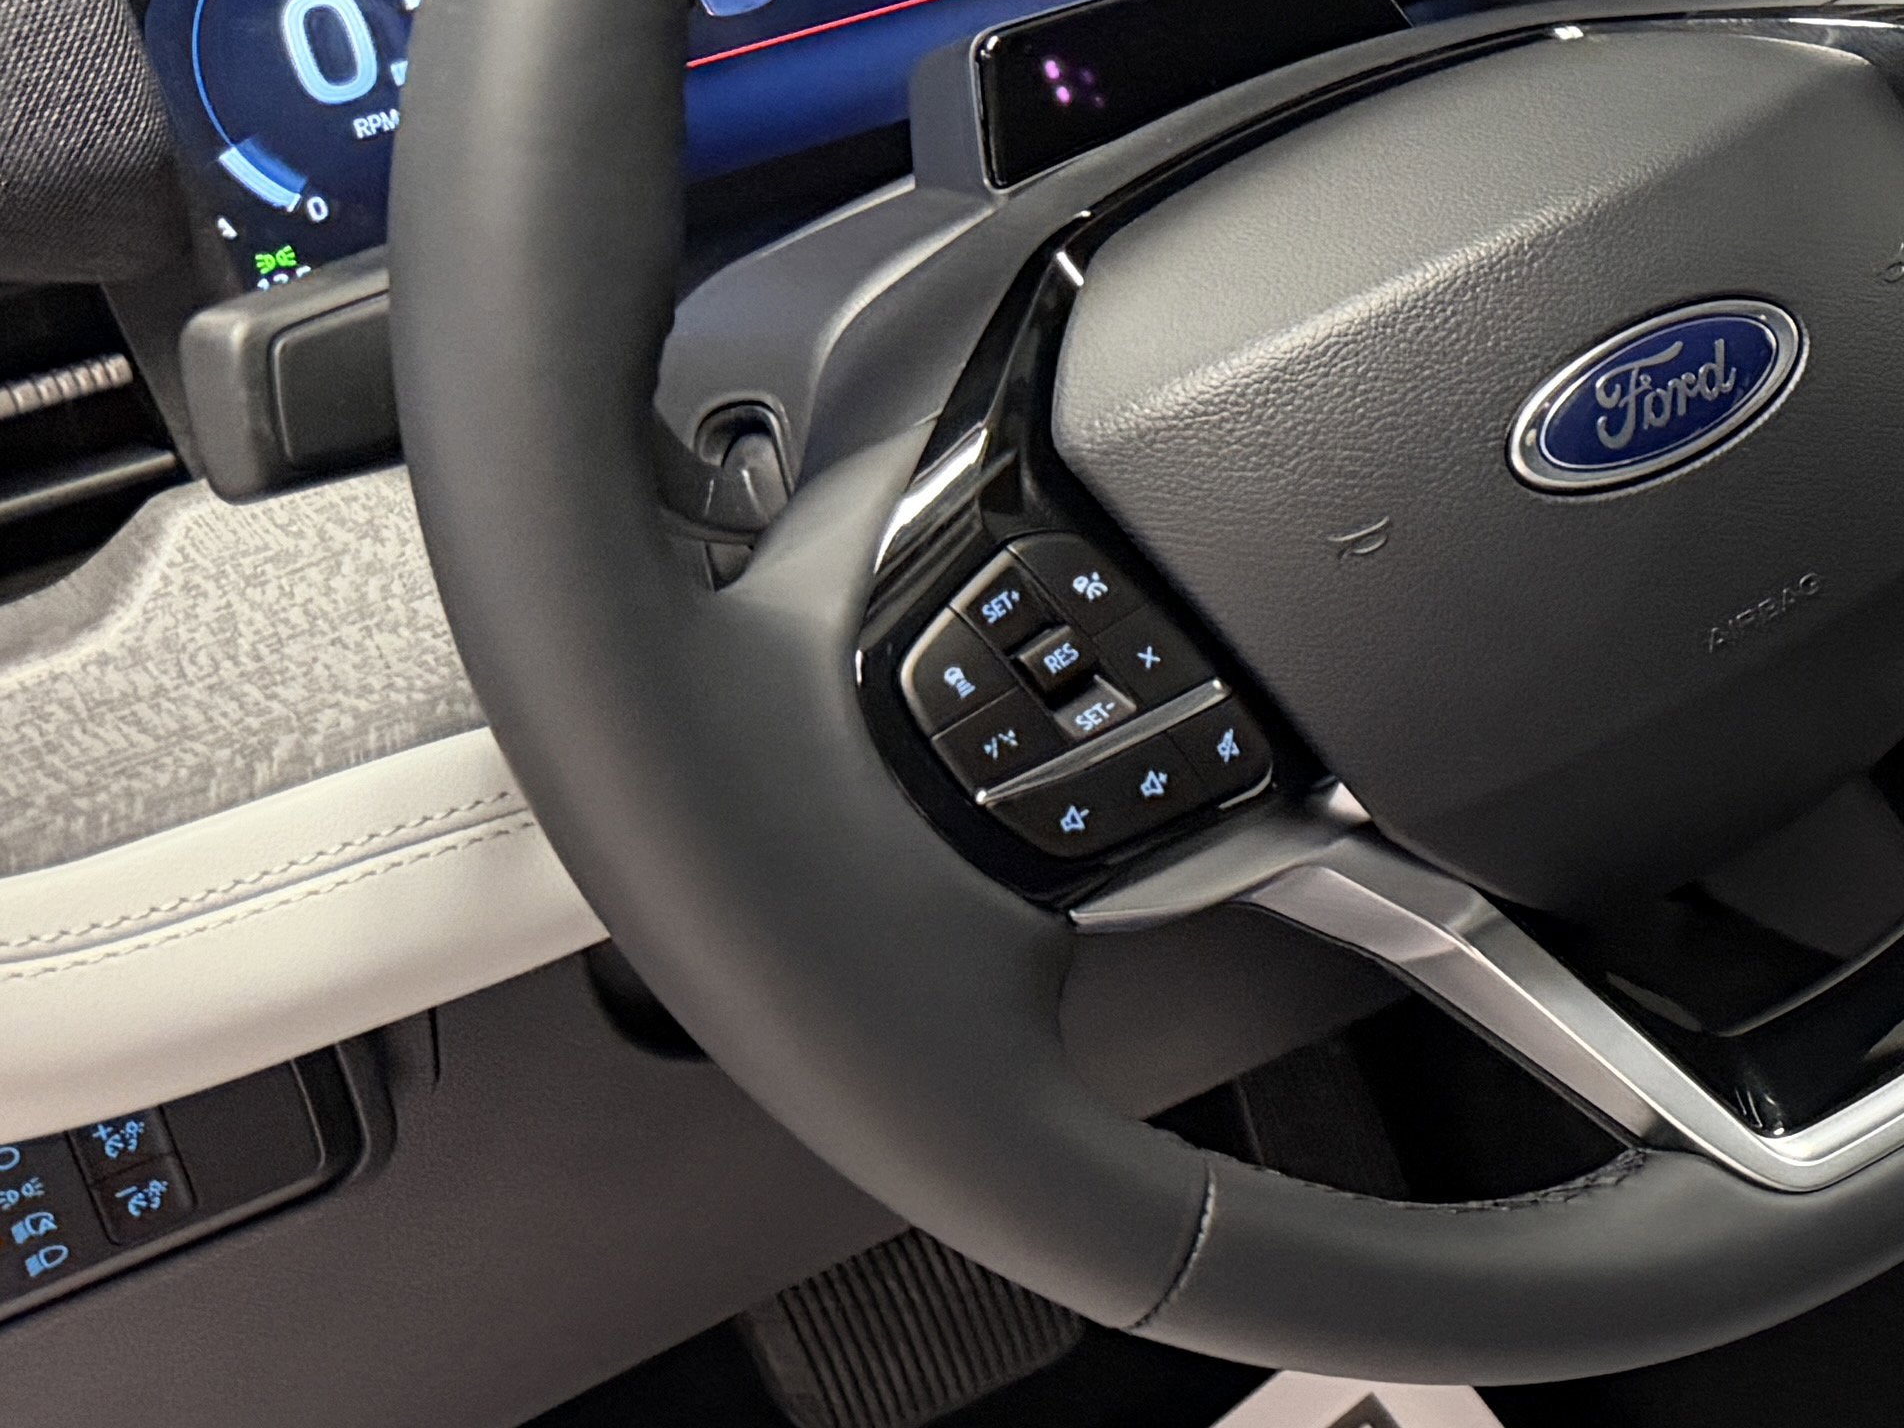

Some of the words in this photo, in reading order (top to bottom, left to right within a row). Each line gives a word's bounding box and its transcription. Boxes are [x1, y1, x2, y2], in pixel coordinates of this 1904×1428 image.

[353, 108, 400, 140] RPM
[306, 195, 329, 223] 0
[1596, 339, 1737, 450] Ford
[982, 589, 1020, 624] SET+
[1043, 643, 1079, 674] RES
